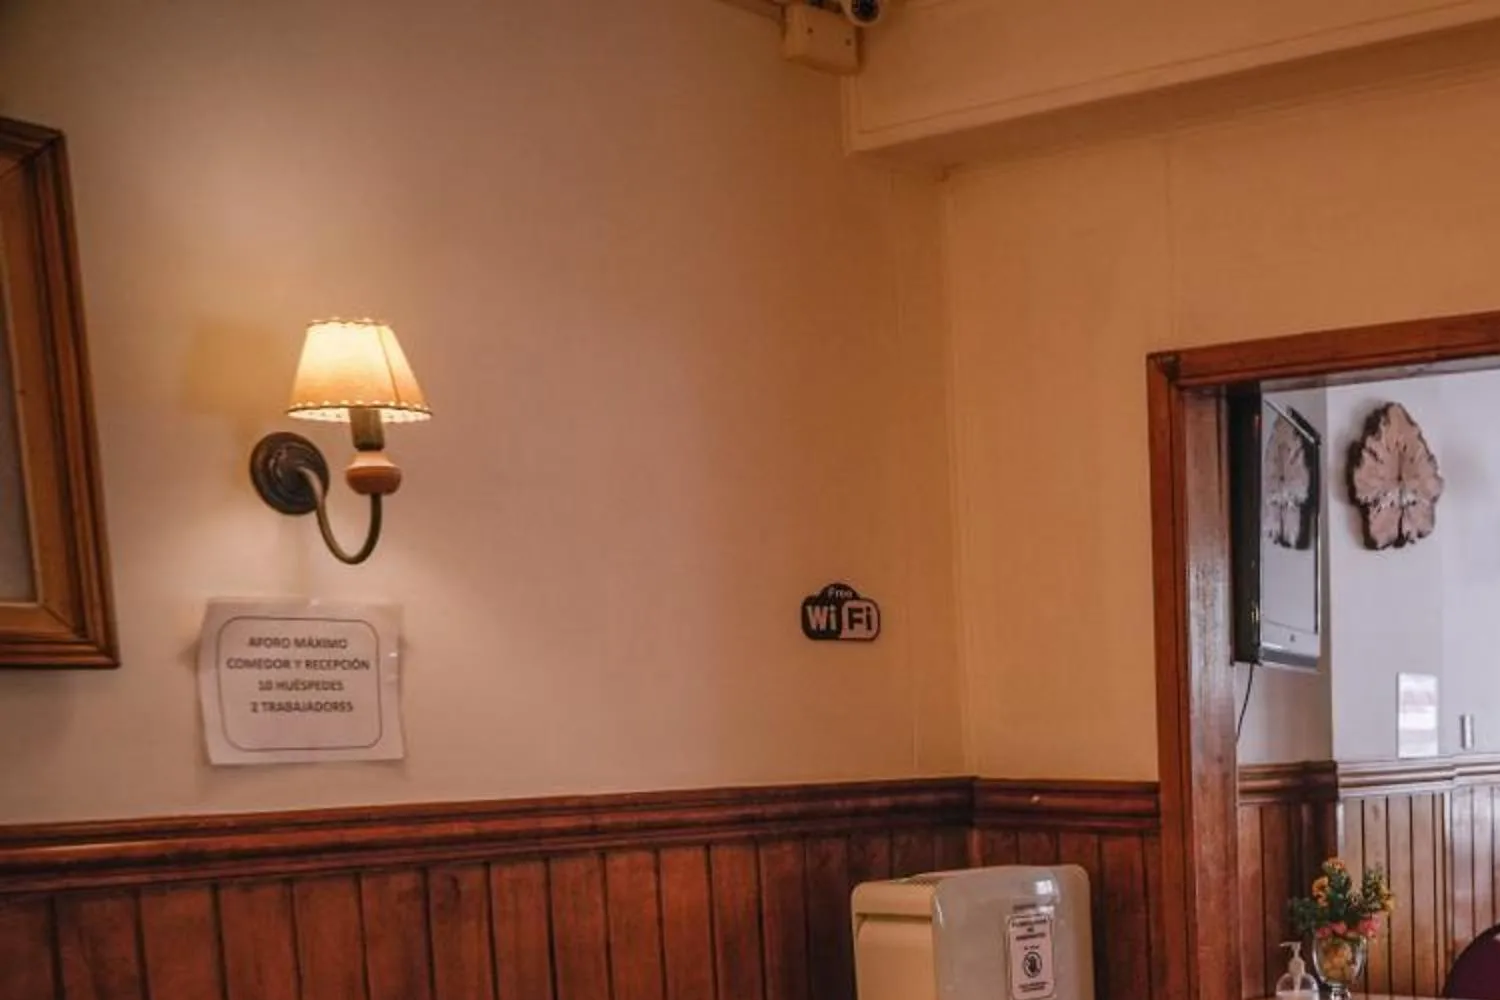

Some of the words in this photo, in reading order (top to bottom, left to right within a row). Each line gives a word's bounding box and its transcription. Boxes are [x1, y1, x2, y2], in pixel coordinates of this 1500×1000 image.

[248, 637, 290, 649] AFORO
[294, 636, 348, 649] MÁXIMO
[226, 658, 291, 670] COMEDOR
[295, 659, 301, 669] Y
[305, 656, 370, 670] RECEPCIÓN
[276, 679, 344, 691] HUÉSPEDES
[250, 702, 259, 713] 2
[262, 701, 354, 713] TRABAJADORES
